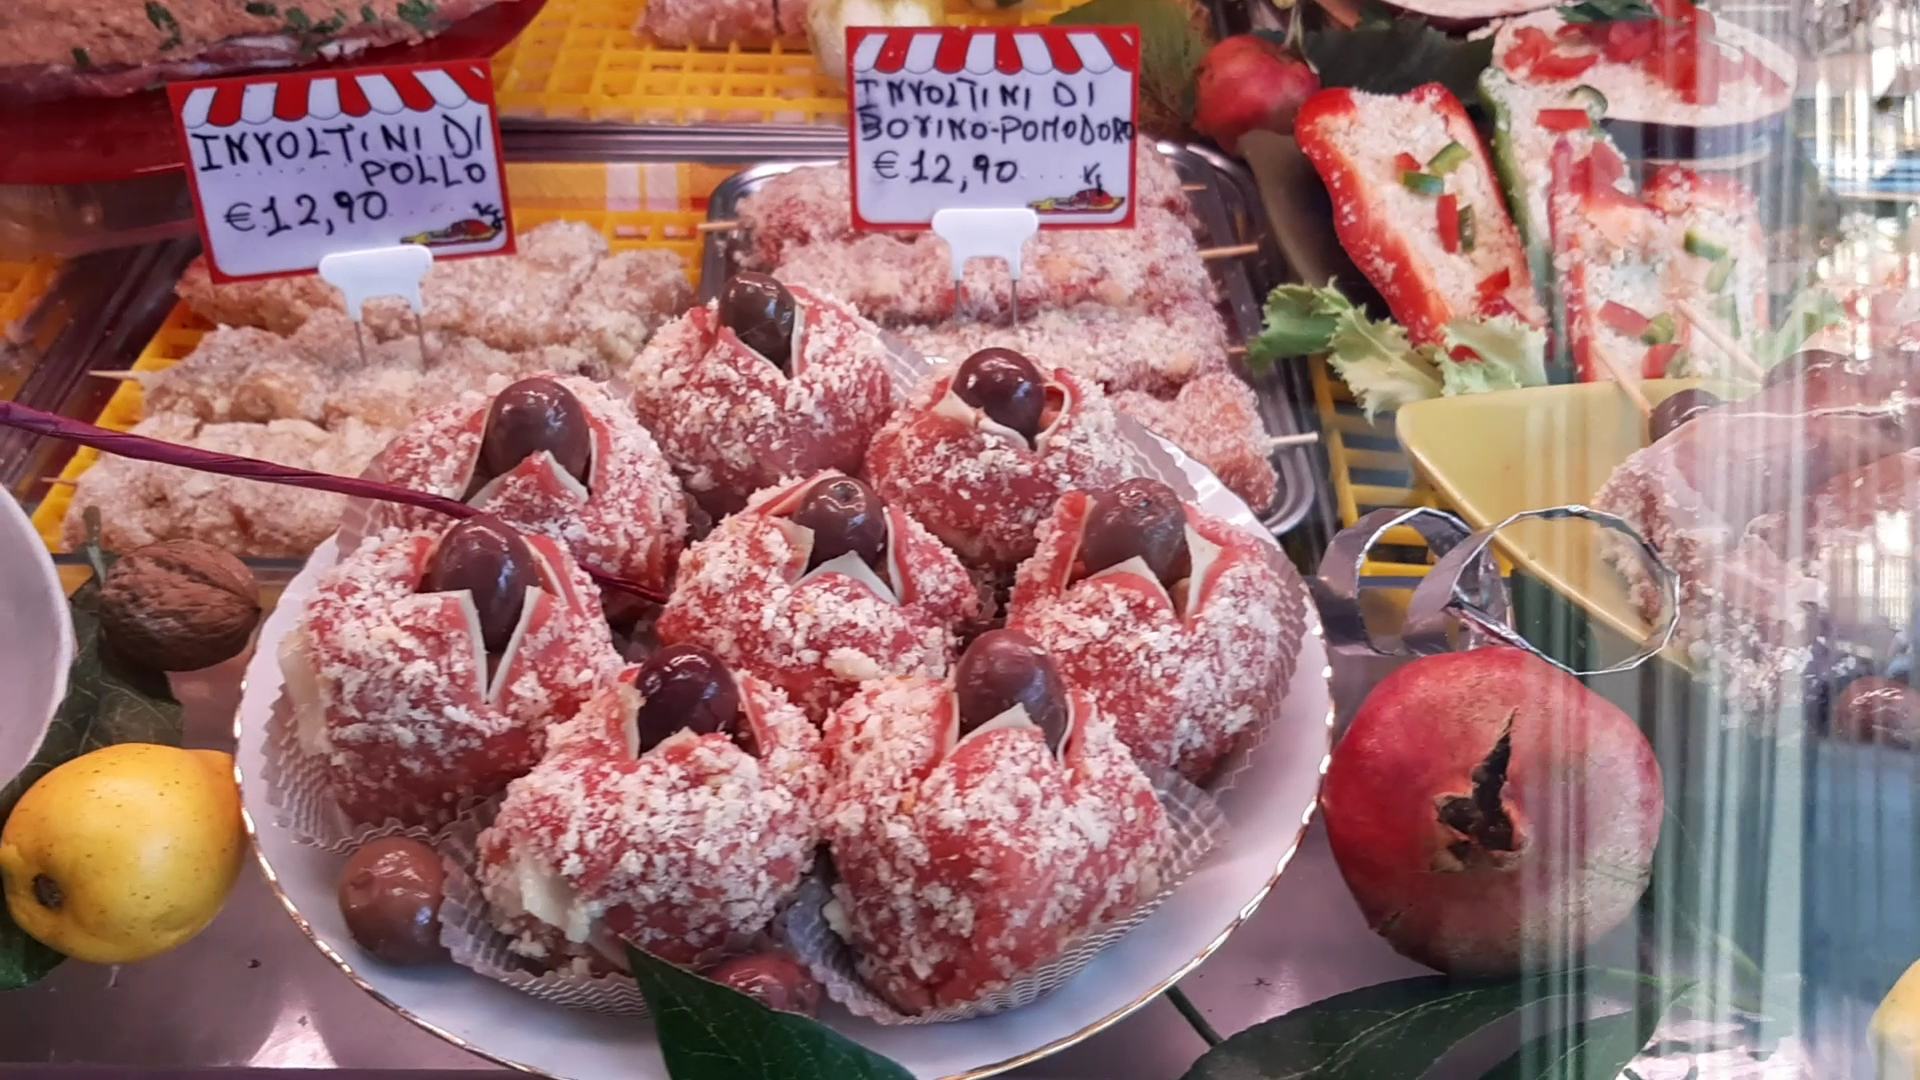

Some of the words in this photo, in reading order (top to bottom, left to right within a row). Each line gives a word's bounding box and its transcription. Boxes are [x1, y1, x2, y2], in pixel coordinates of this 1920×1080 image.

[856, 77, 1031, 111] INVOLTINI
[1053, 81, 1095, 107] DI
[191, 122, 422, 172] INVOLTINI
[441, 114, 482, 159] DI
[858, 112, 1136, 145] BOVINO-POMODORO
[361, 154, 487, 187] POLLO
[873, 150, 1018, 193] €12,90
[224, 190, 389, 237] €12,90
